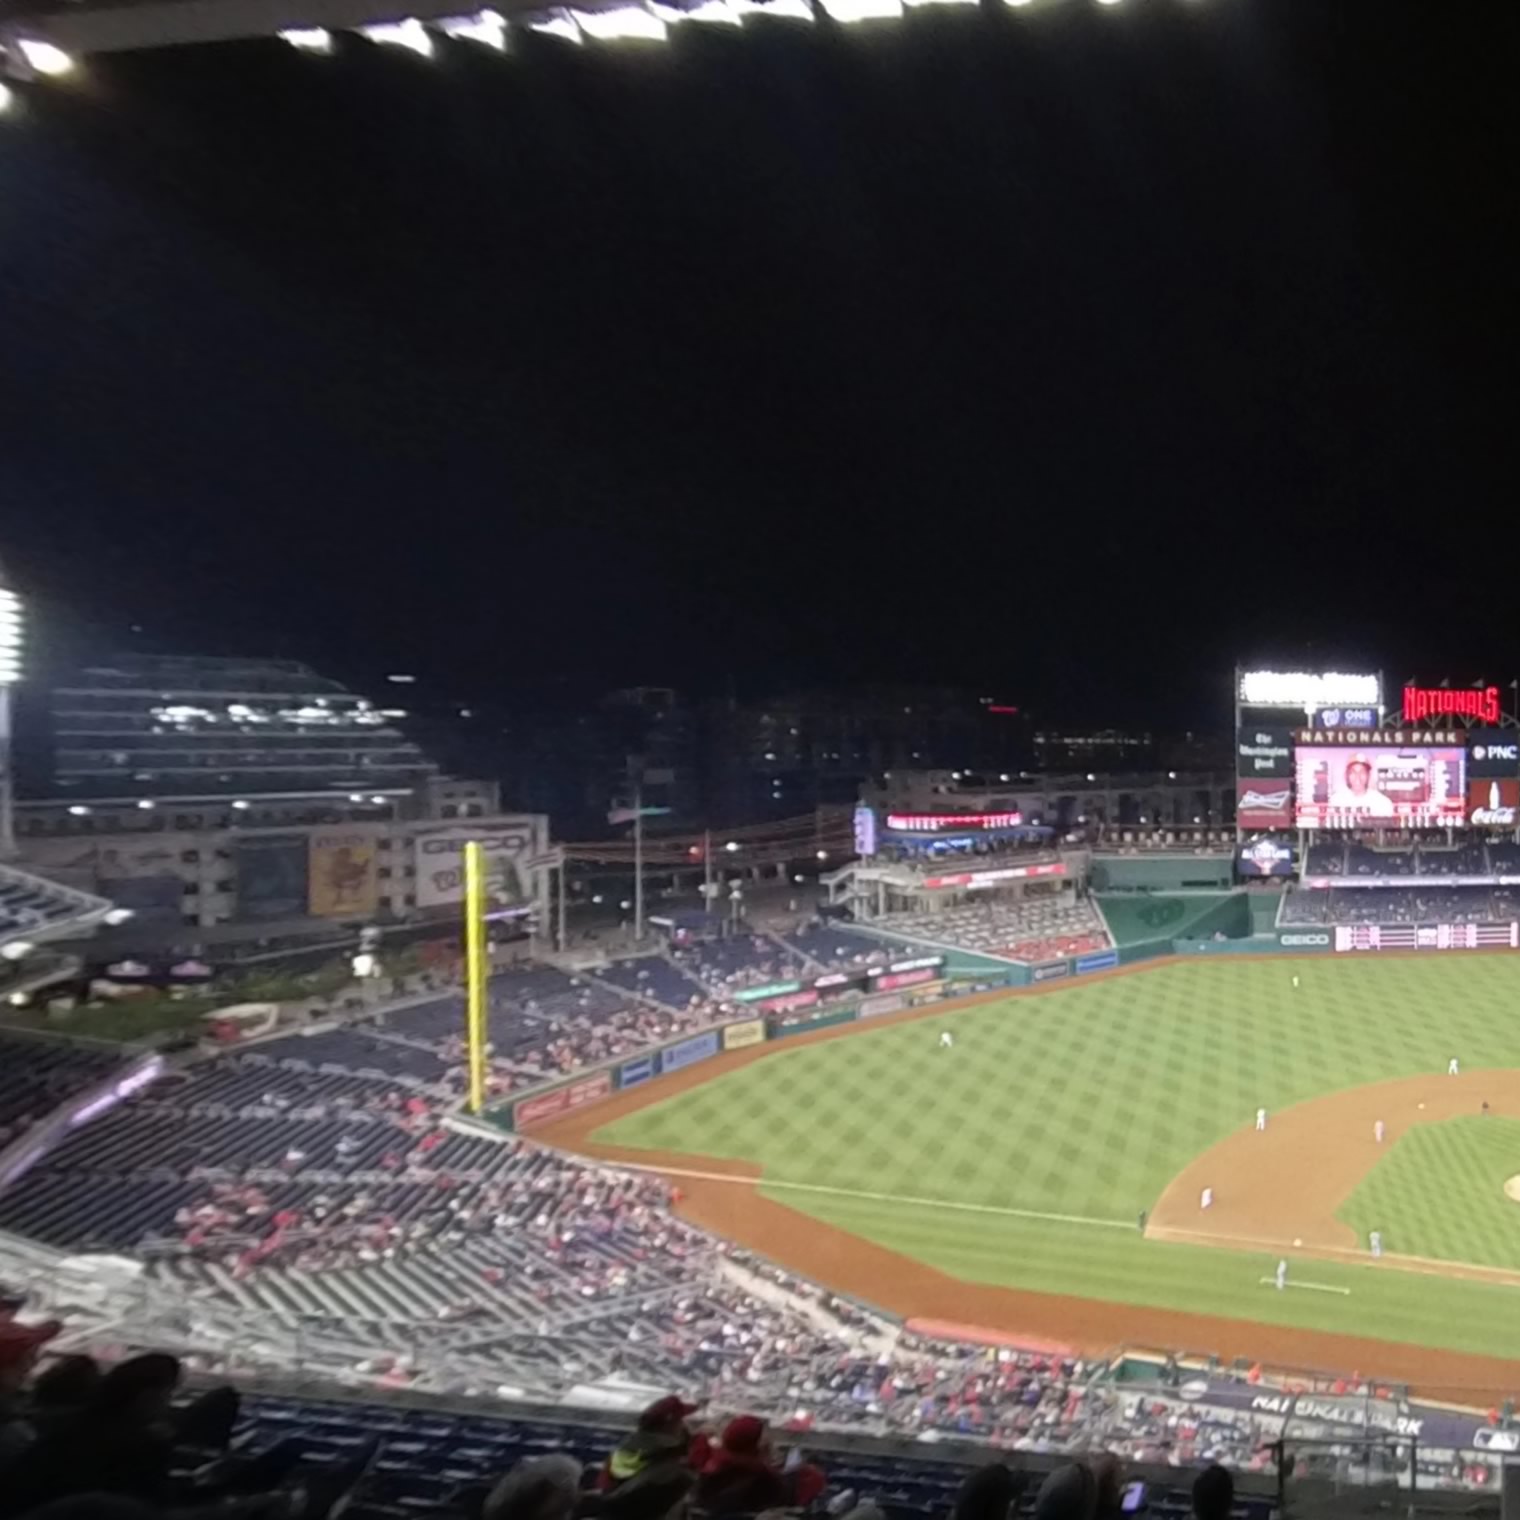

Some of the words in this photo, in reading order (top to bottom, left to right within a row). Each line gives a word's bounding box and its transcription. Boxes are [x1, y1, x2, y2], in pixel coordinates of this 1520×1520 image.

[1403, 686, 1499, 722] NATIONALS
[1344, 709, 1372, 722] ONE
[1301, 732, 1404, 743] NATIONALS
[1412, 732, 1457, 743] PARK
[1239, 744, 1289, 757] Washington
[1487, 745, 1517, 759] PNC
[422, 833, 526, 855] GECO
[1280, 933, 1329, 946] GEICO
[1252, 1395, 1364, 1424] NATONALS
